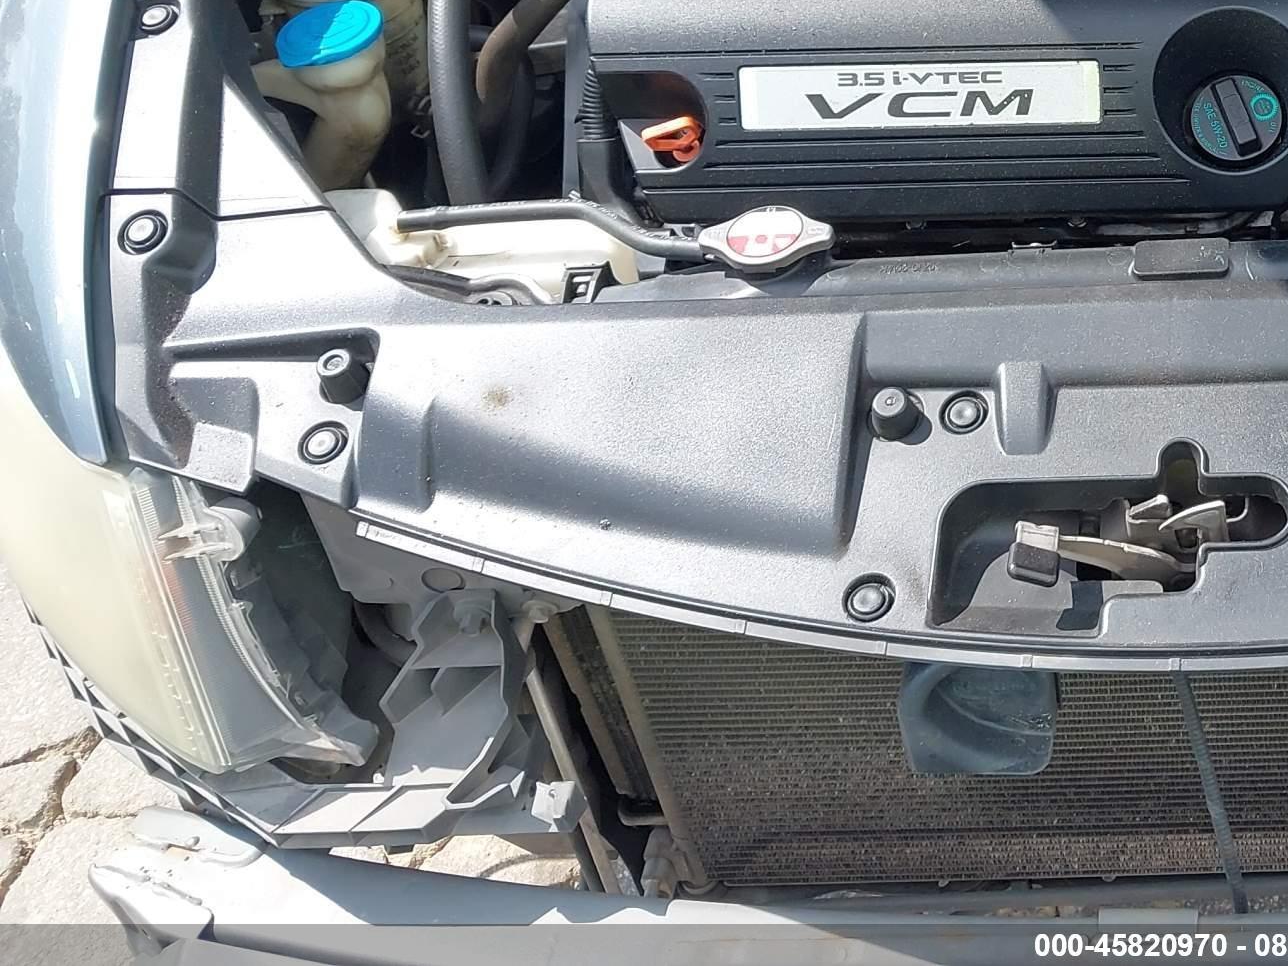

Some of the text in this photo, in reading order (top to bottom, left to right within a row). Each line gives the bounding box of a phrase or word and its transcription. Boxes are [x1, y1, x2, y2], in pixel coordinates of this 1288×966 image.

[837, 71, 1003, 87] 3.5 i-VTEC
[805, 89, 1034, 119] VCM
[1203, 102, 1217, 120] SAE
